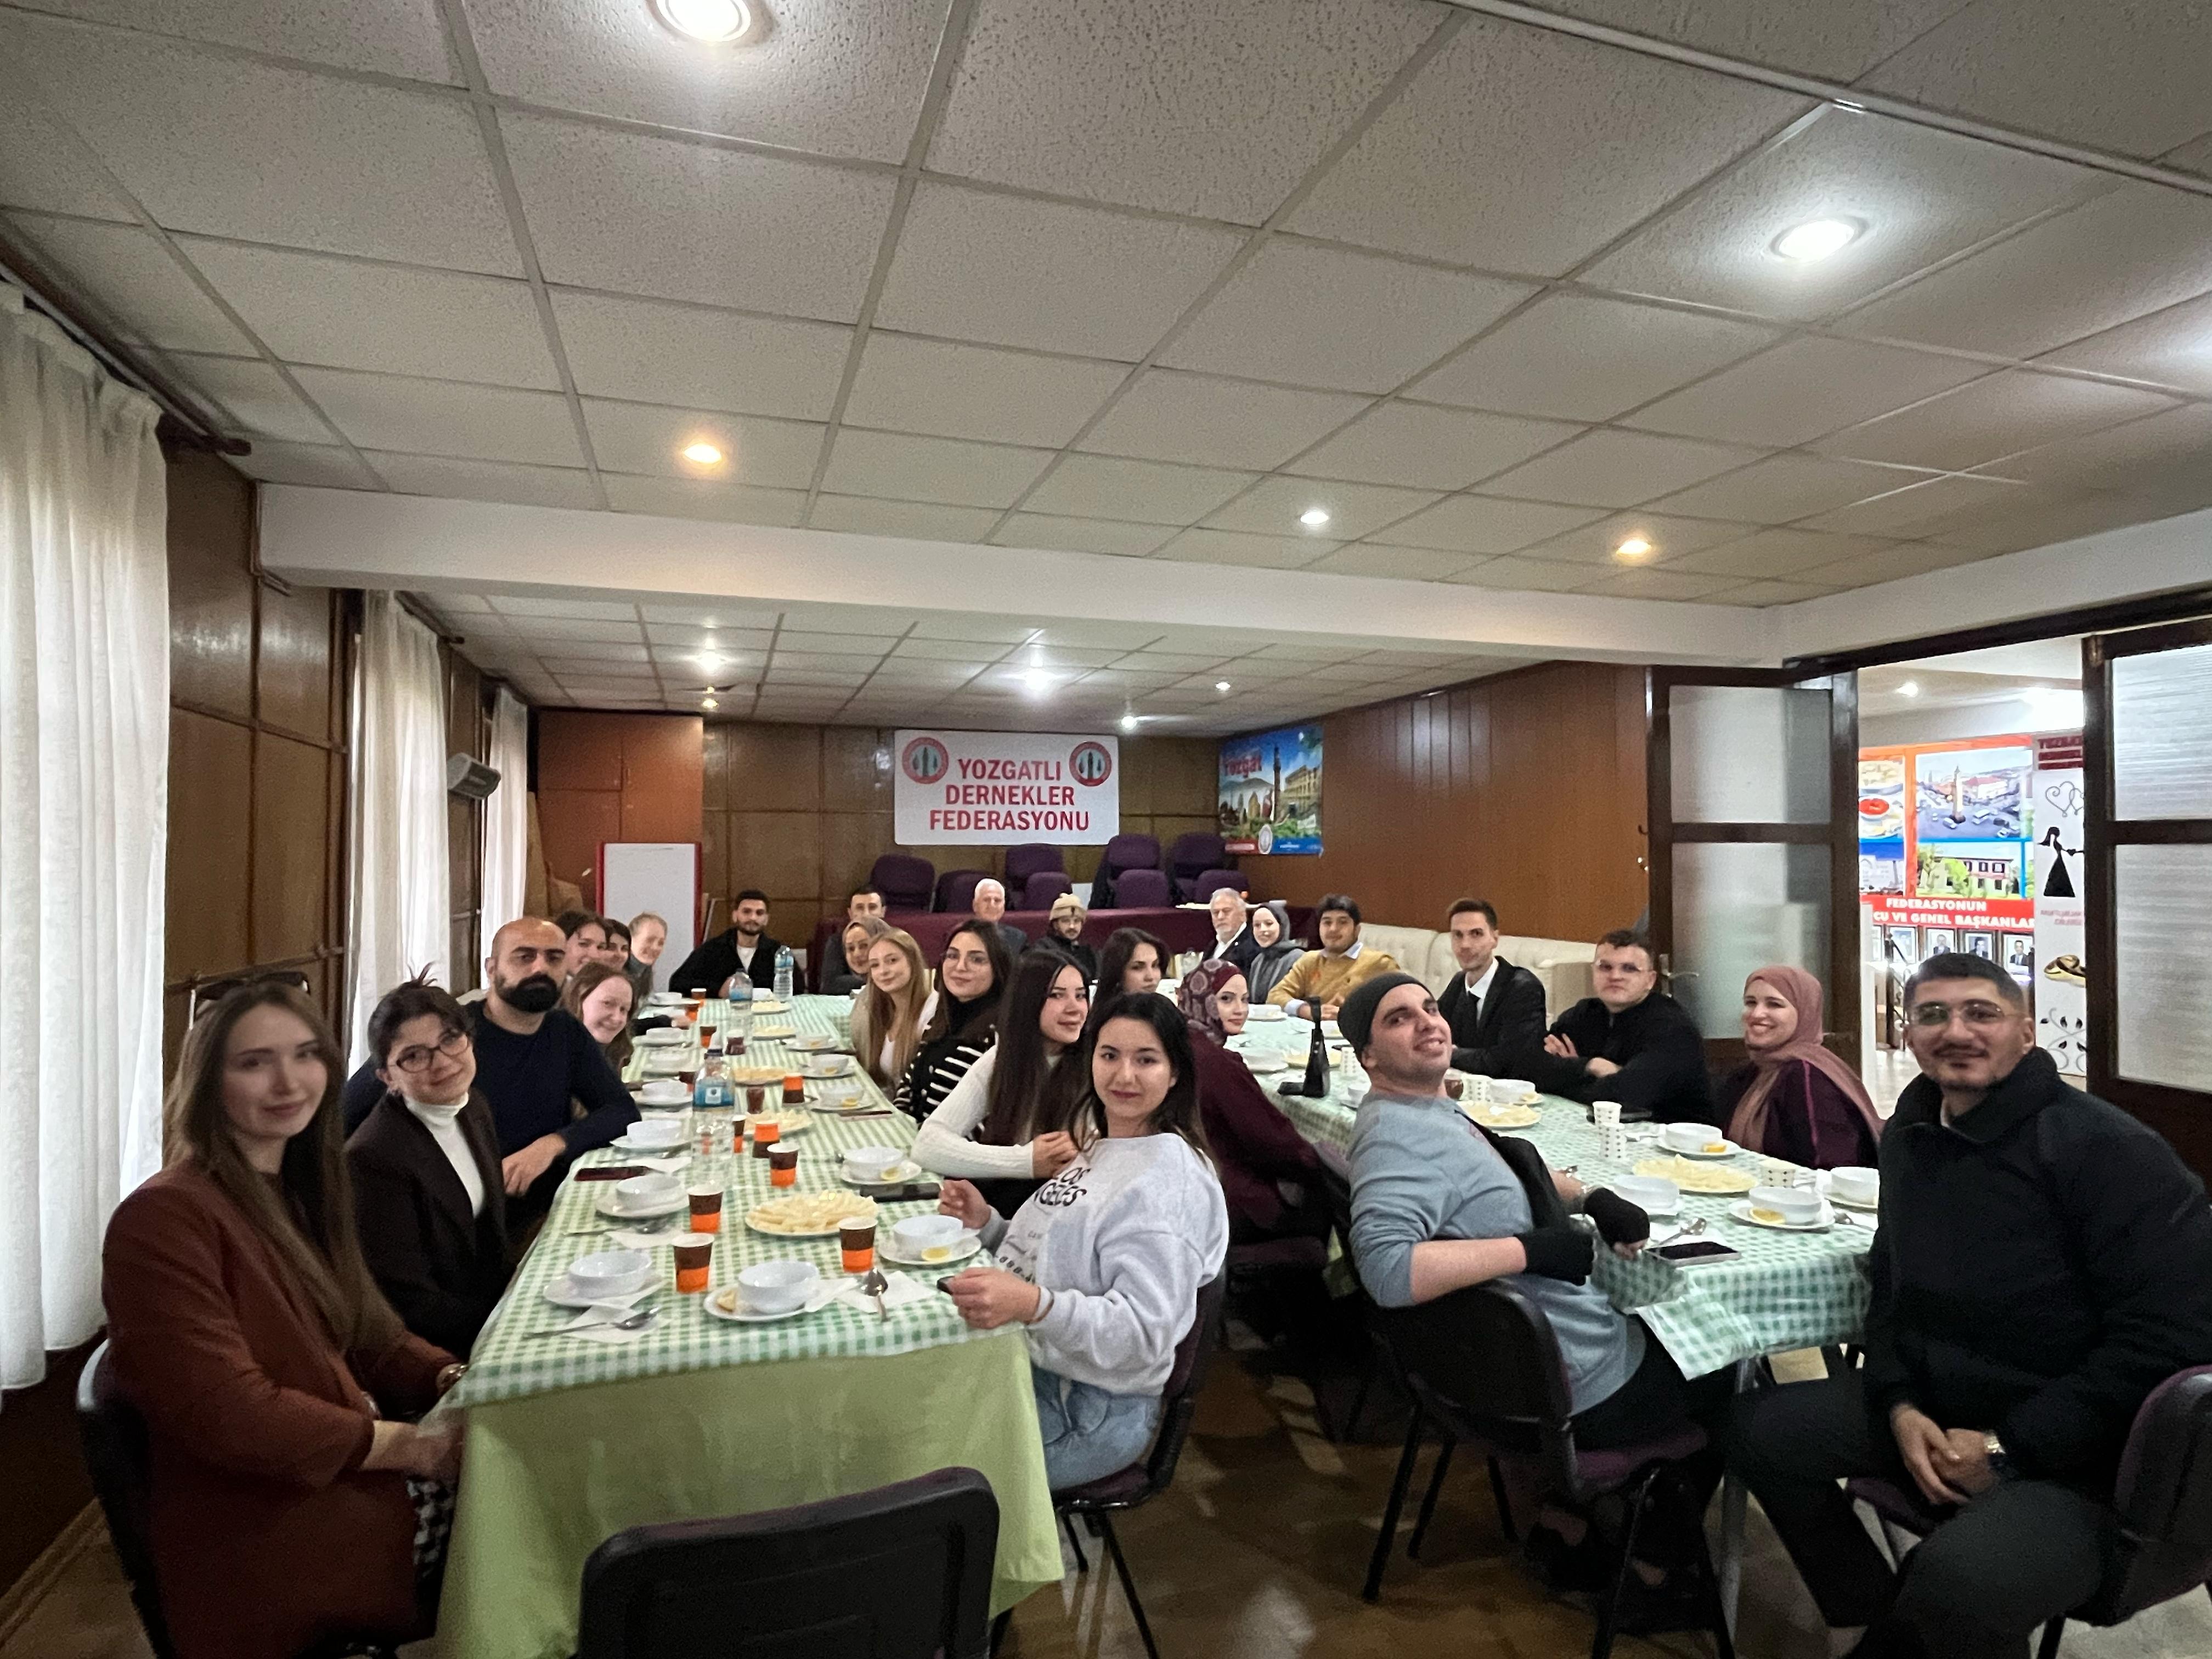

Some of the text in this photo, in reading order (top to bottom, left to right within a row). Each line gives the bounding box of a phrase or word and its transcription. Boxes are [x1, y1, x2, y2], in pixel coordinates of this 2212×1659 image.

[957, 758, 1061, 781] YOZGATLI
[946, 785, 1074, 806] DERNEKLER
[930, 810, 1089, 831] FEDERASYONU
[1886, 898, 1987, 912] FEDERASYONUN
[1892, 912, 1907, 922] VE
[1910, 913, 1952, 924] GENEL
